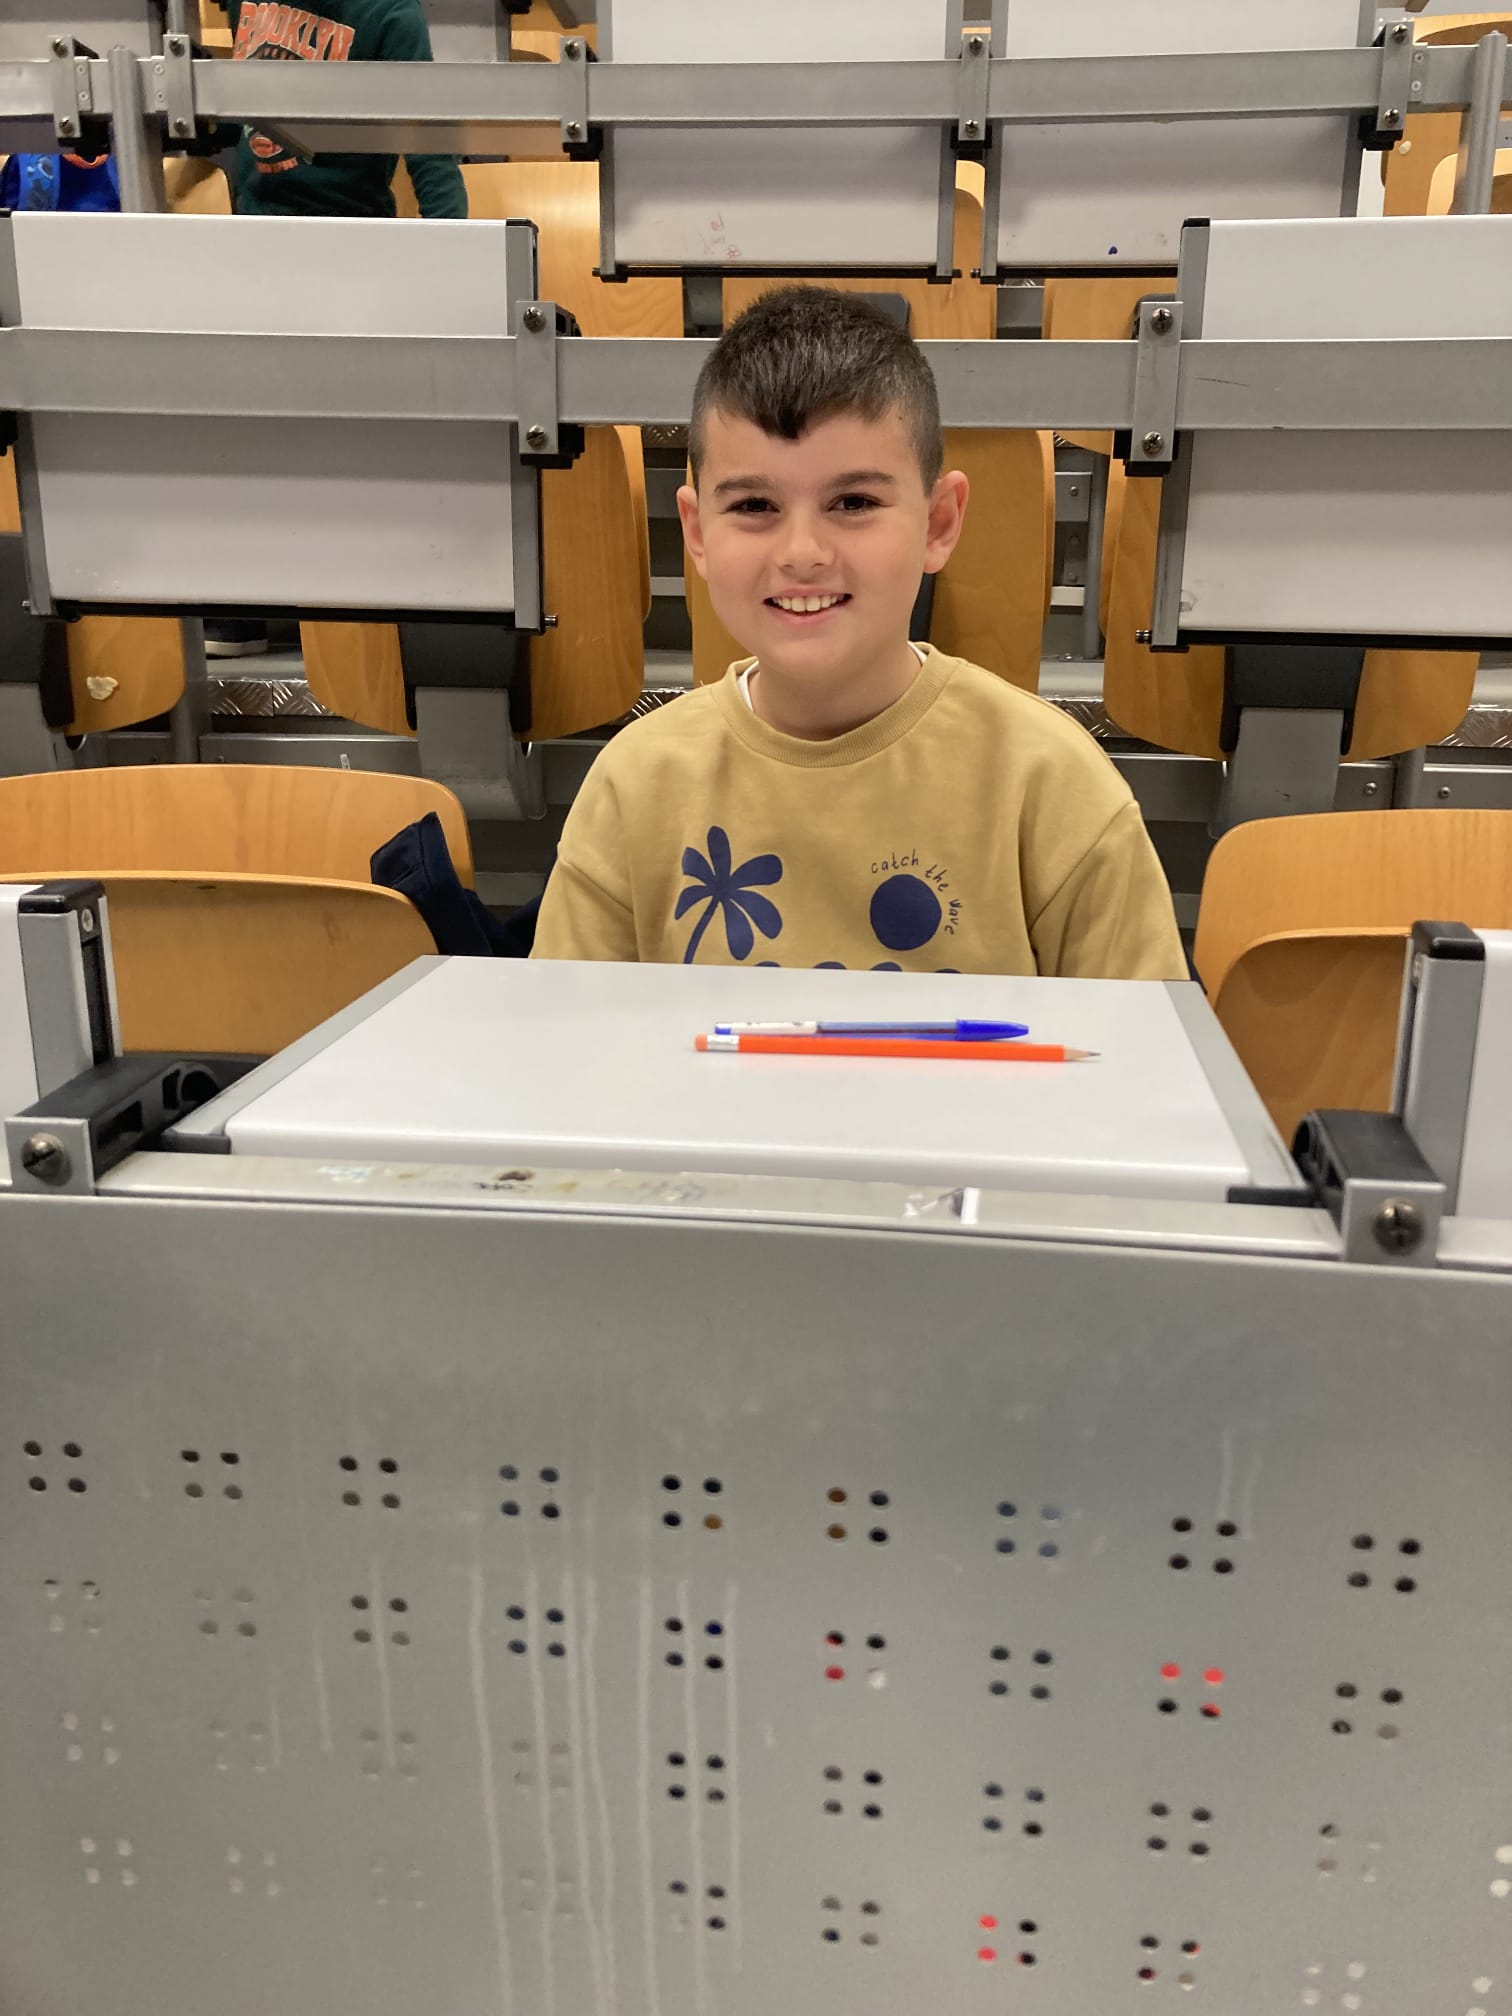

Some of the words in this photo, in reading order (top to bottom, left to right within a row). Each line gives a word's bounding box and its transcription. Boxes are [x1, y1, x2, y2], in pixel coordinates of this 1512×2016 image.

[871, 848, 919, 874] catch
[925, 864, 949, 892] the
[944, 898, 963, 935] wave
